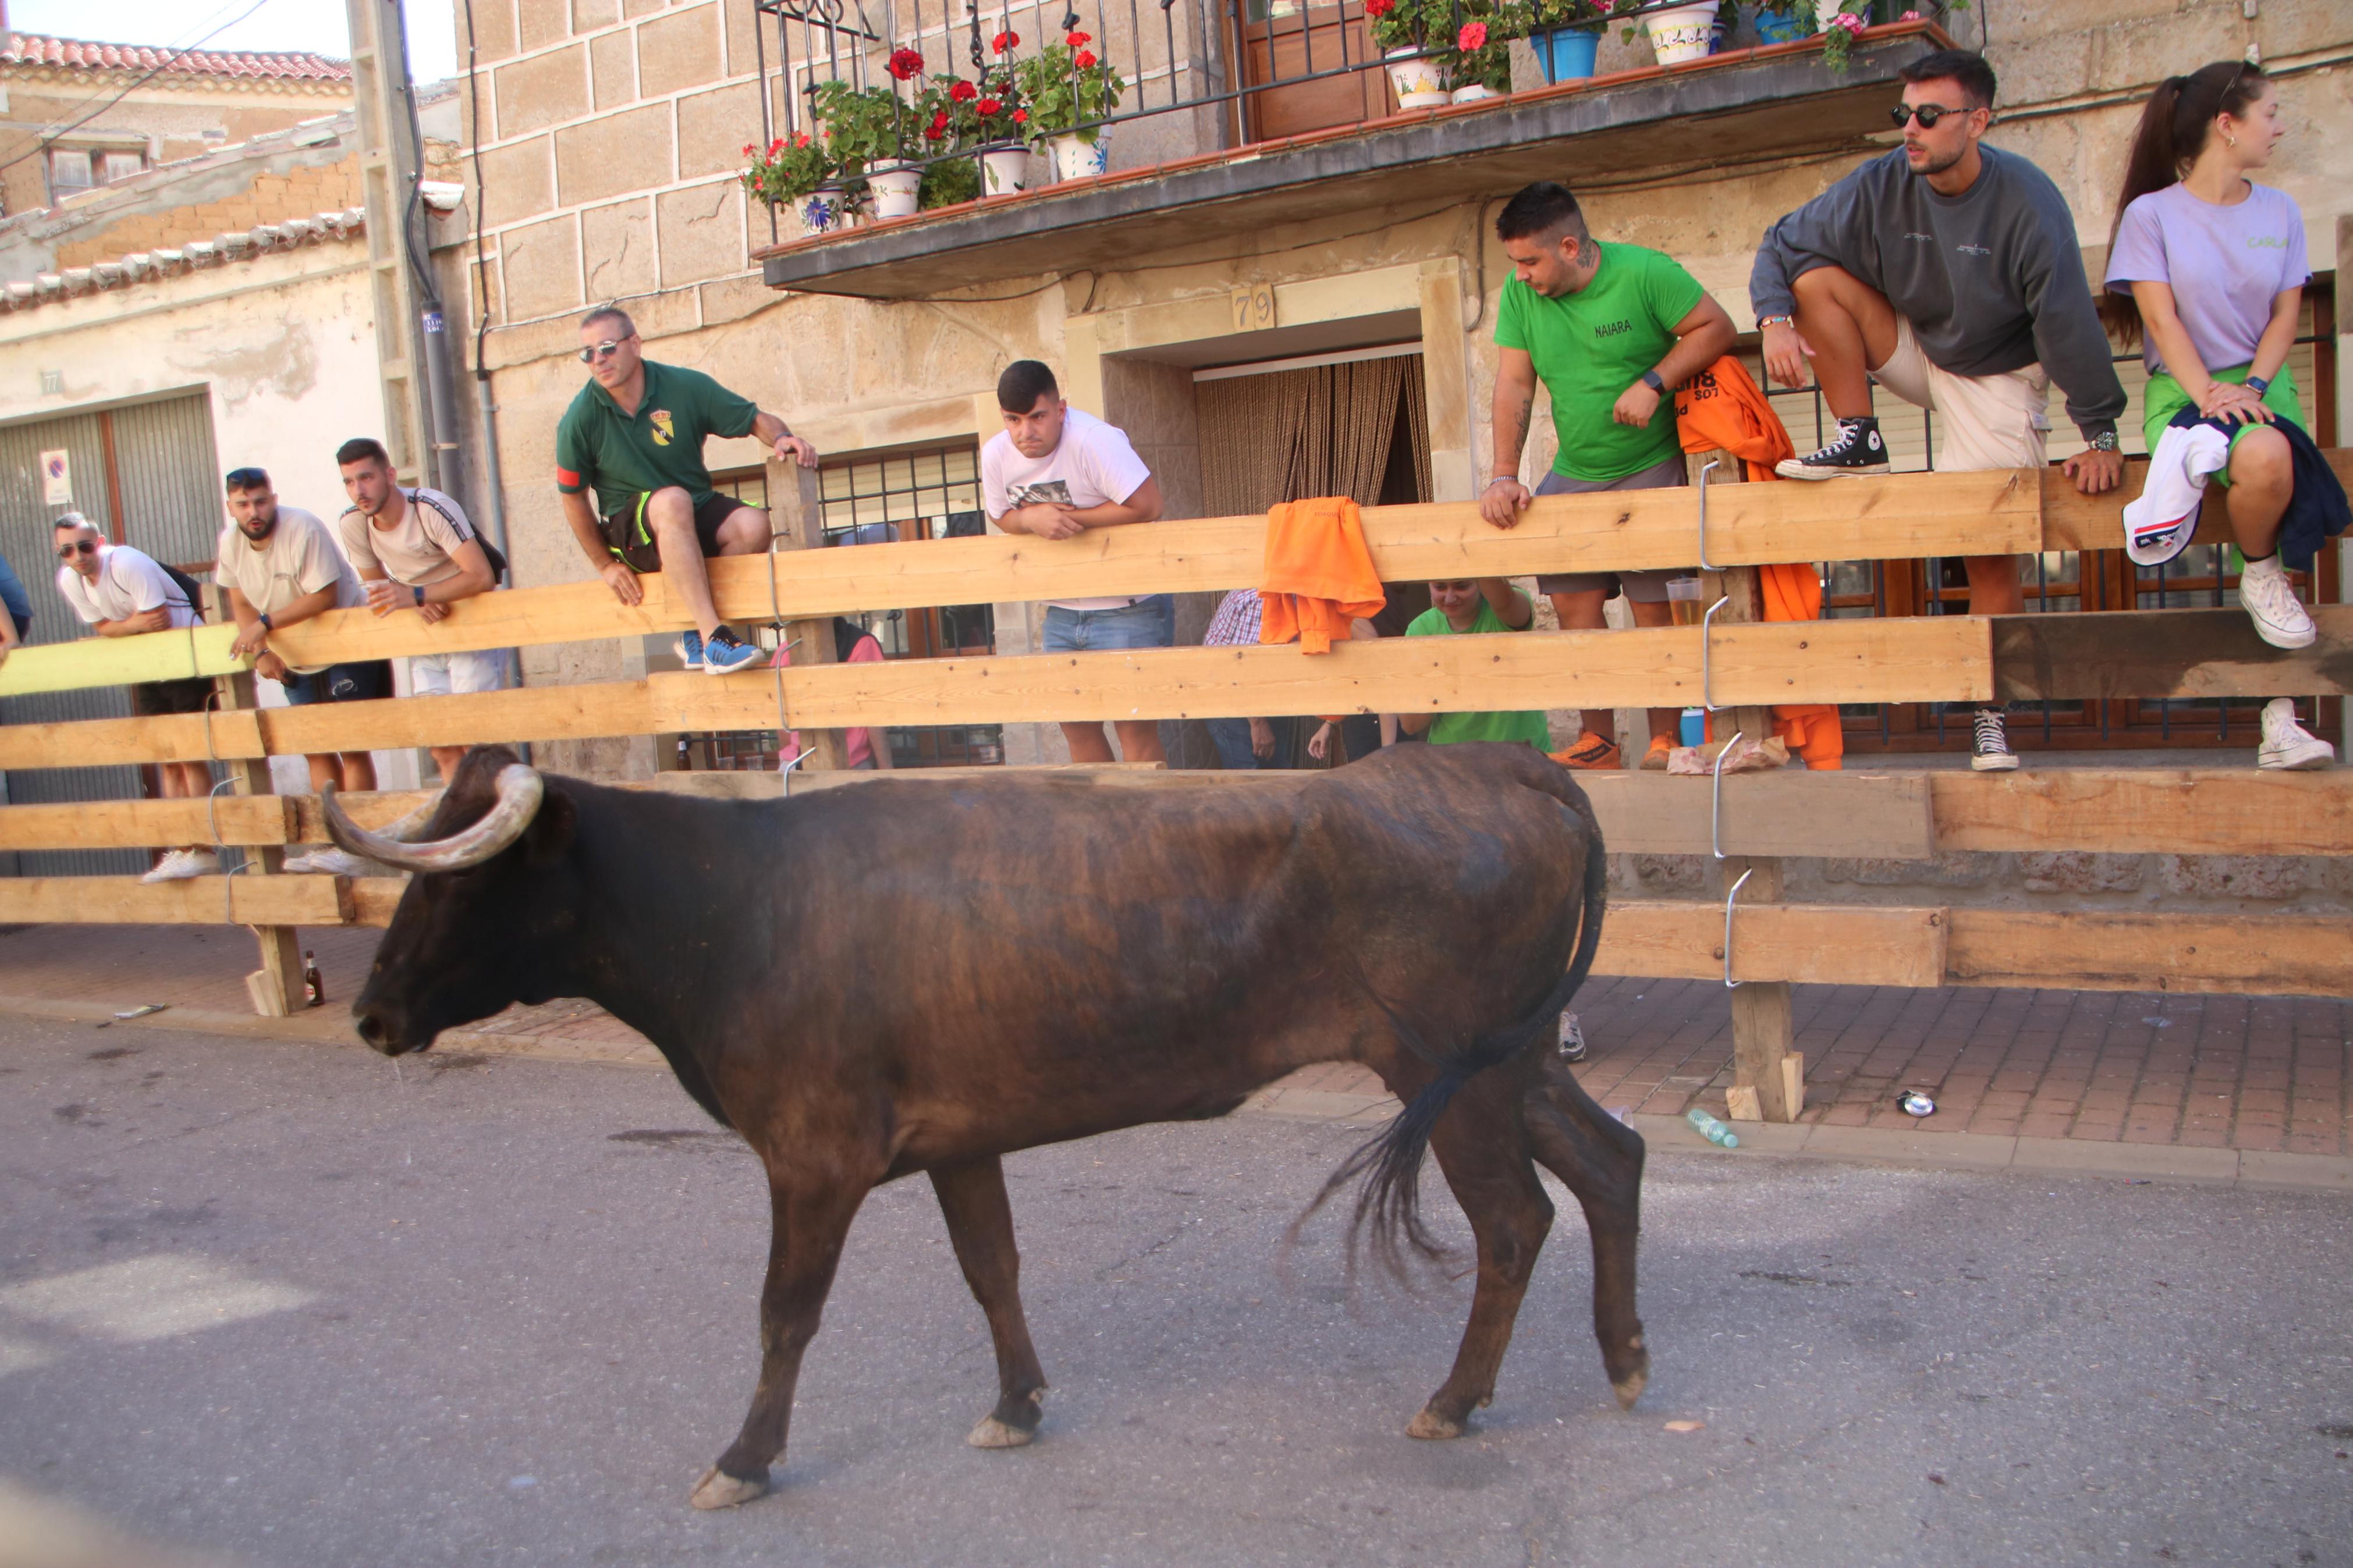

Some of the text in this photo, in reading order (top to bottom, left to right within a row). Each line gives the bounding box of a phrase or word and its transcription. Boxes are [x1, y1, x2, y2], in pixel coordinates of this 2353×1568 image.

[1235, 291, 1272, 328] 79
[1595, 318, 1632, 338] NAIARA
[45, 375, 57, 392] 77
[1694, 387, 1719, 401] LOS
